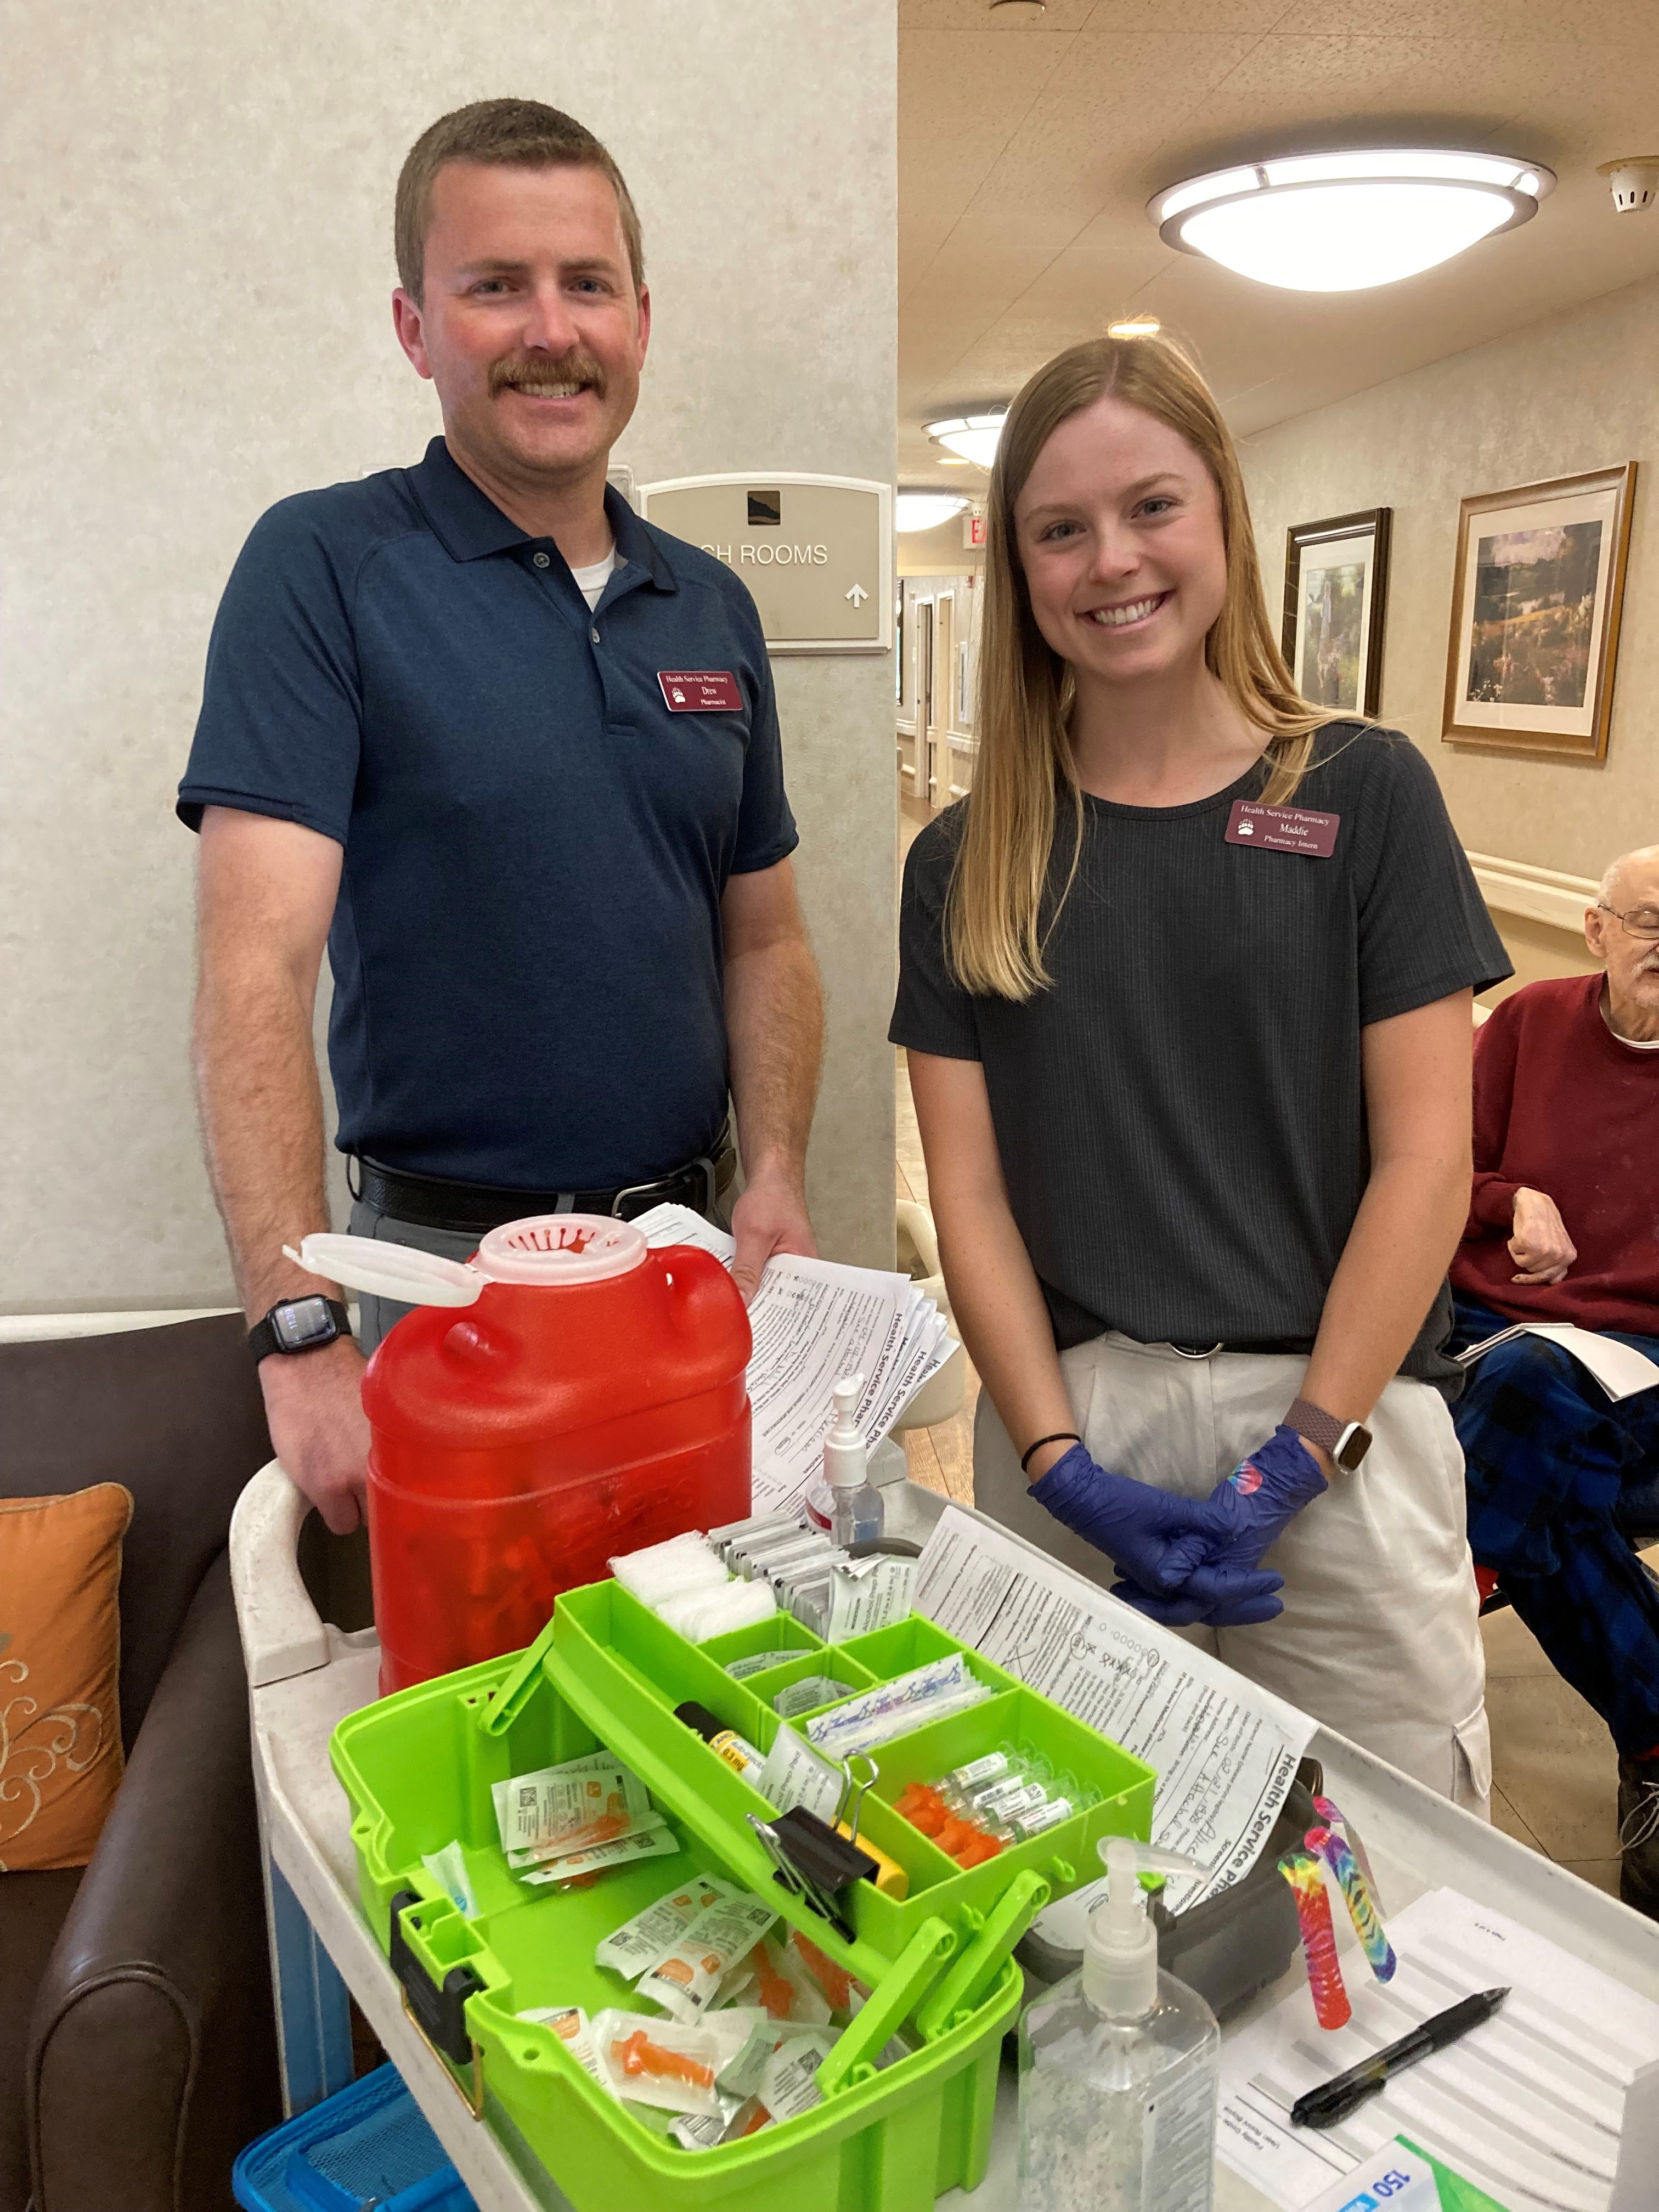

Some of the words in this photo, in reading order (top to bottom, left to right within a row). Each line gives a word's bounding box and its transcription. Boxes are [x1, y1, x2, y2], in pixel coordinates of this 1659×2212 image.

[741, 545, 827, 565] ROOMS
[702, 687, 716, 695] Drew
[1241, 805, 1264, 815] Health
[1267, 810, 1293, 820] Service
[1295, 814, 1329, 826] Pharmacy
[1264, 835, 1295, 847] Pharmacy
[1280, 824, 1309, 836] Maddie
[885, 1312, 902, 1352] Health
[867, 1354, 889, 1397] Service
[902, 1350, 927, 1387] Health
[878, 1389, 905, 1428] Service
[862, 1599, 874, 1631] Alcohol
[869, 1578, 878, 1598] Prep
[1037, 1590, 1053, 1613] Patient
[1166, 1689, 1177, 1705] have
[1215, 1697, 1229, 1717] Home
[1150, 1705, 1169, 1734] Medicare
[1190, 1703, 1200, 1715] and
[1248, 1718, 1263, 1742] Patient
[1240, 1741, 1253, 1761] Name
[731, 1756, 746, 1771] mg
[1166, 1758, 1180, 1776] Bring
[1228, 1760, 1244, 1784] (please
[1265, 1753, 1297, 1810] Health
[1231, 1810, 1273, 1870] Service
[1372, 2168, 1411, 2198] 150
